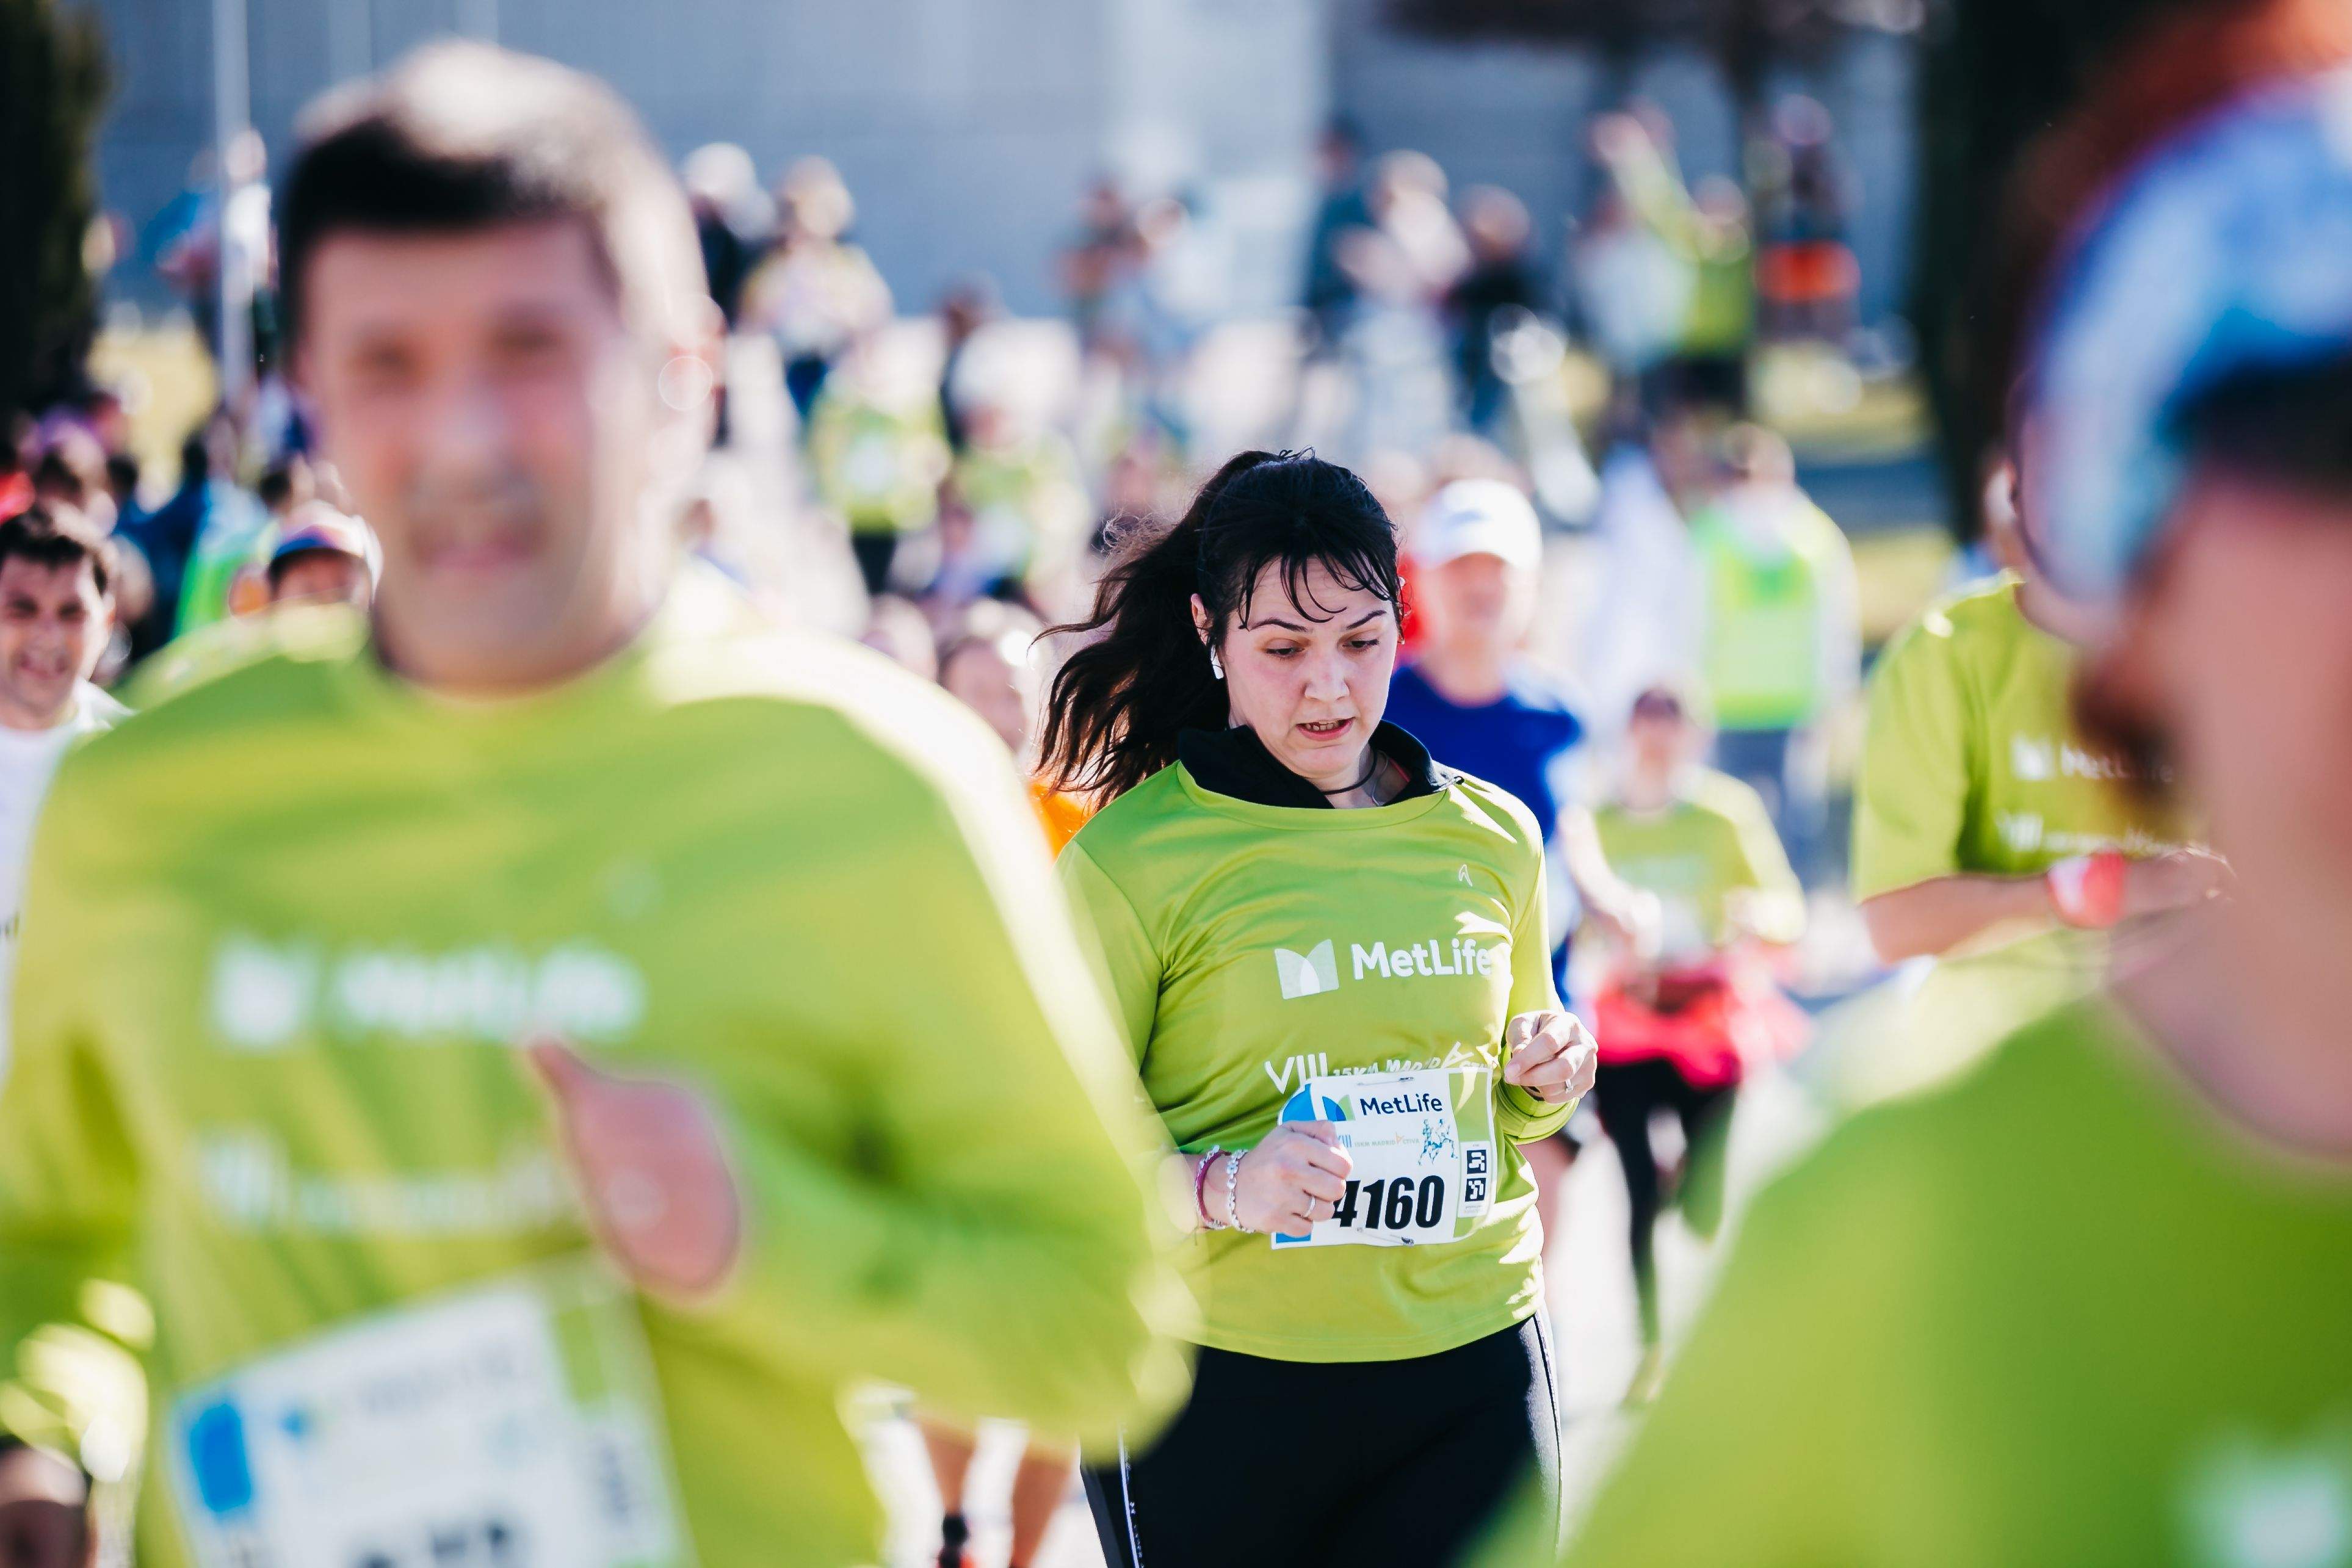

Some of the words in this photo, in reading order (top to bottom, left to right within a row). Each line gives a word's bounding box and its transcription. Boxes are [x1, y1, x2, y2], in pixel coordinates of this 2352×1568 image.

[1350, 938, 1493, 980] MetLife
[1359, 1093, 1443, 1116] MetLife
[1331, 1175, 1445, 1230] 4160
